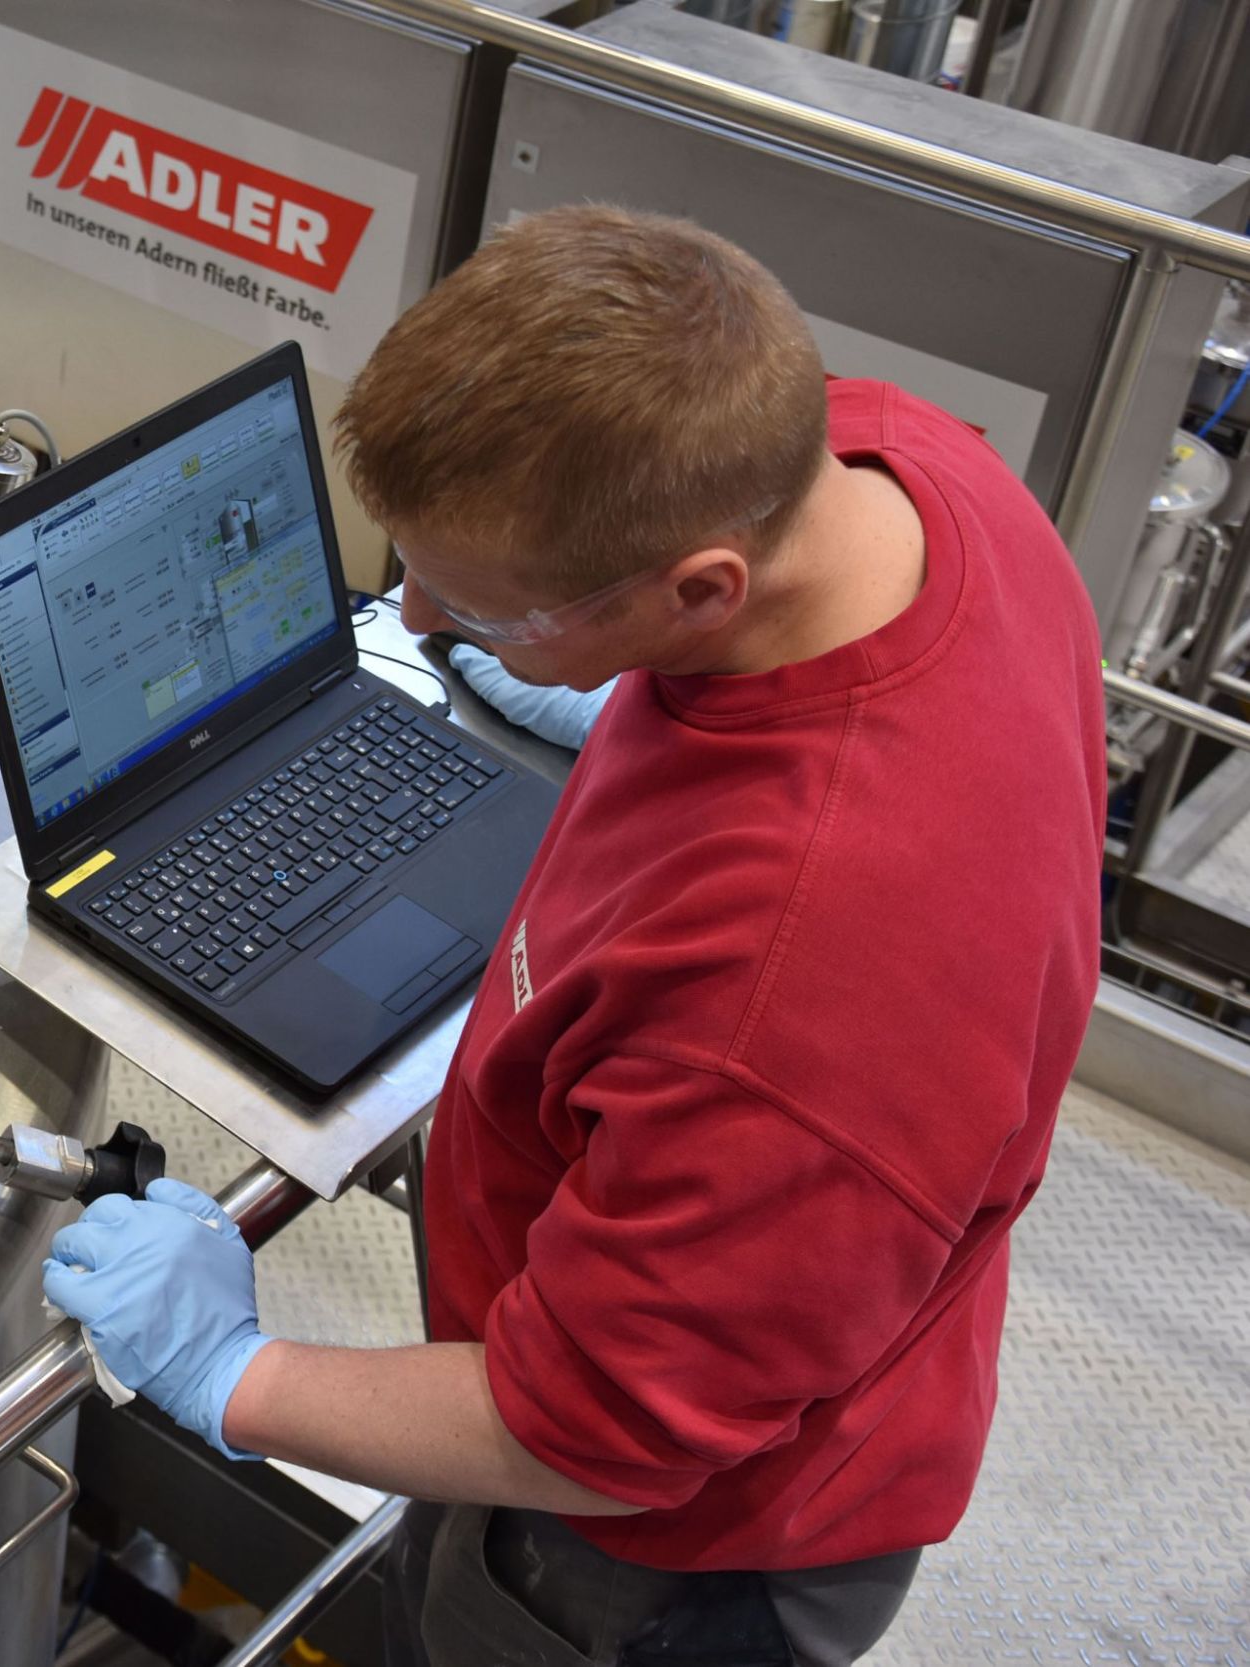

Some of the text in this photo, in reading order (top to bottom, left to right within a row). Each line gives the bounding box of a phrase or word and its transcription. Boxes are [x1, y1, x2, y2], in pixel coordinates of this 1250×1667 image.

[89, 129, 329, 267] ADLER
[26, 192, 331, 331] In unseren Adern fließt Farbe.
[190, 730, 211, 749] DELL
[512, 949, 529, 1010] ADL
